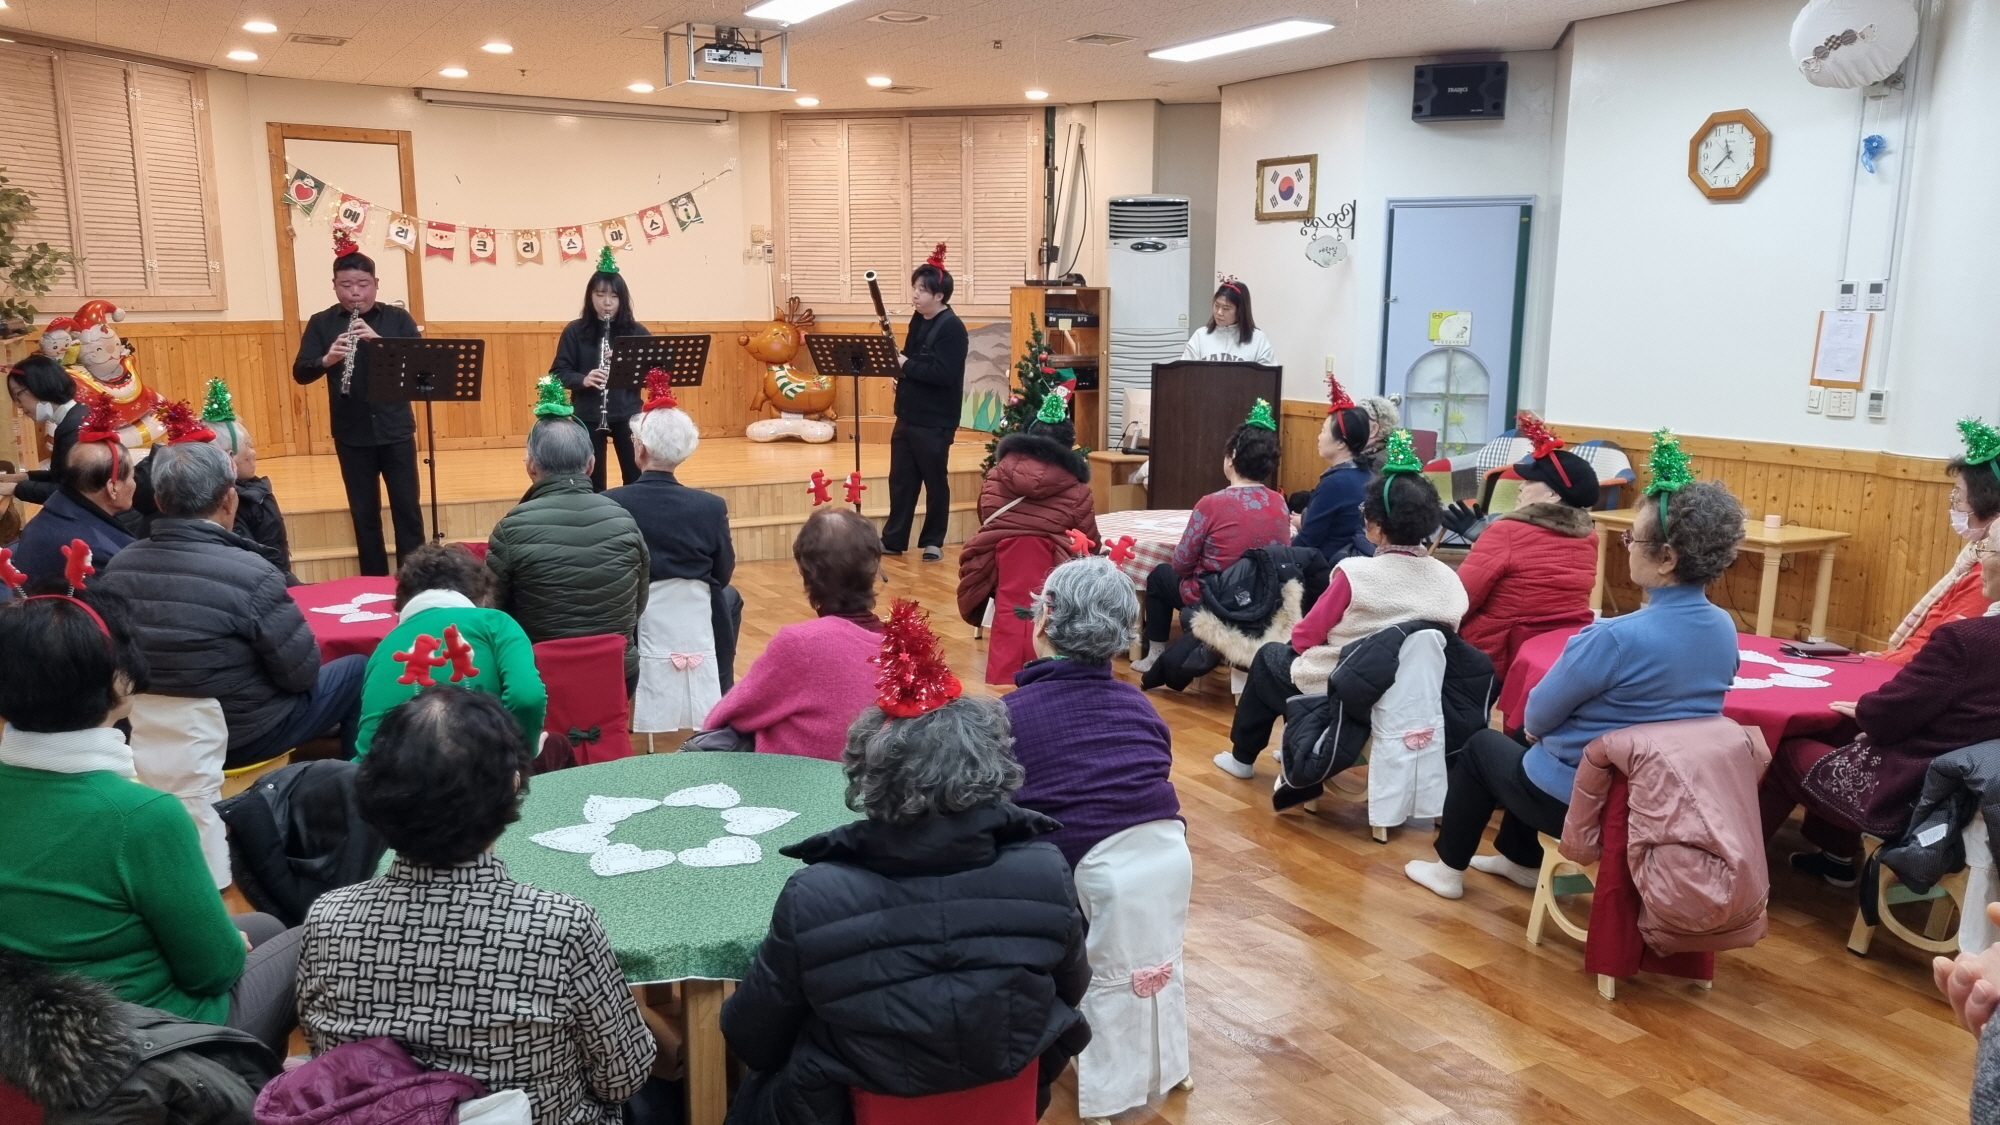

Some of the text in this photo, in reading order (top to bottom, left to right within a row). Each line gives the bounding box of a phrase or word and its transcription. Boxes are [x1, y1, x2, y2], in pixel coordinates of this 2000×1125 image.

[1714, 128, 1721, 137] 11
[1726, 124, 1735, 134] 12
[1704, 141, 1713, 150] 10
[1703, 152, 1709, 161] 9
[1703, 165, 1710, 175] 8
[1713, 175, 1719, 185] 7
[1723, 176, 1730, 185] 6
